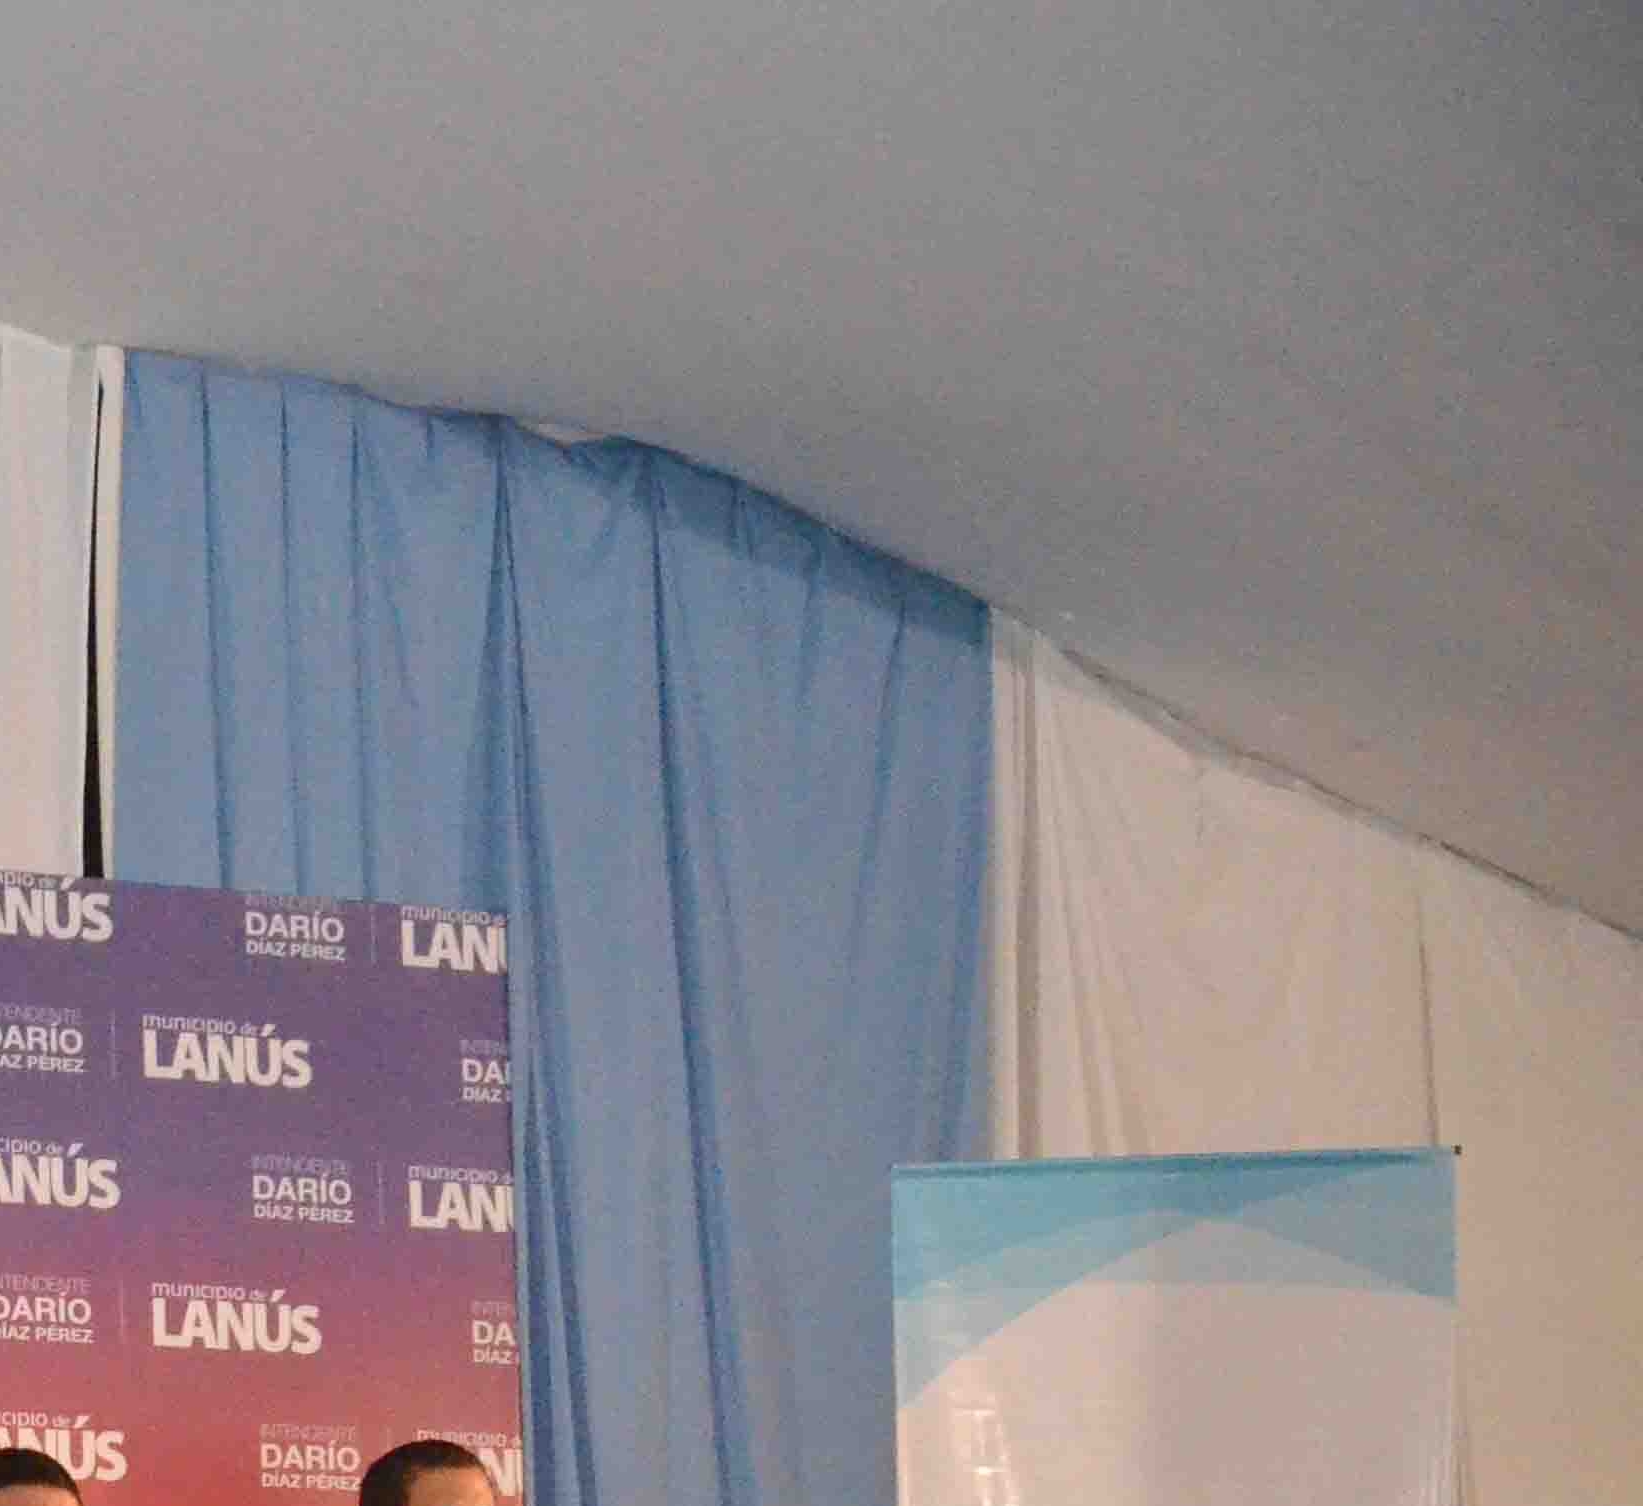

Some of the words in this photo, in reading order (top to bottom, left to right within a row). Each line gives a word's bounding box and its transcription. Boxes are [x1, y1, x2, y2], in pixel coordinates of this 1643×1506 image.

[245, 911, 344, 942] DARÍO
[144, 1024, 312, 1088] LANÚS
[252, 1173, 352, 1205] DARÍO
[35, 1324, 93, 1343] PÉREZ
[152, 1289, 322, 1354] LANÚS
[260, 1440, 360, 1472] DARÍO
